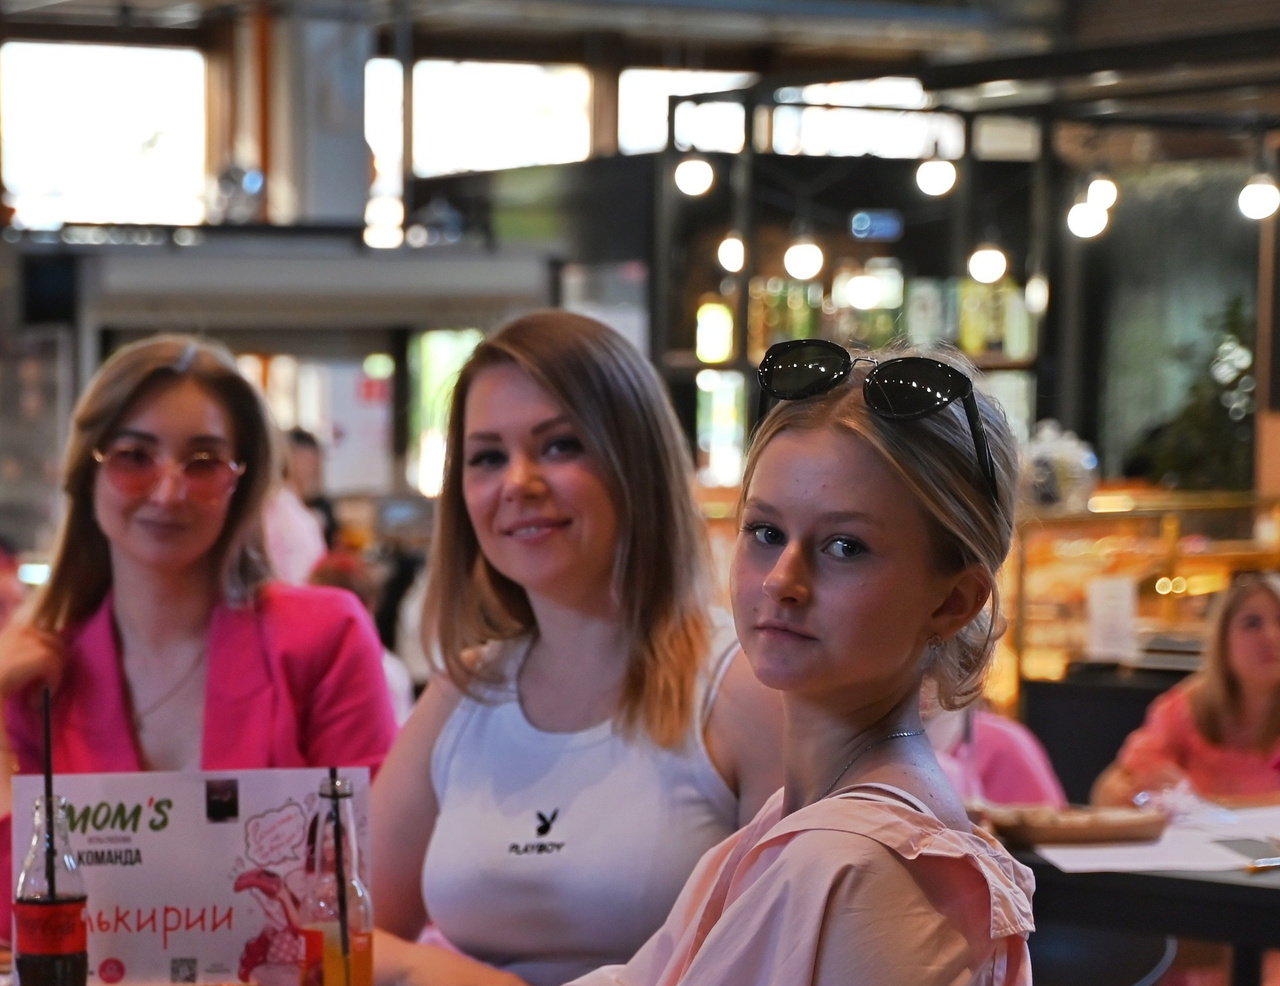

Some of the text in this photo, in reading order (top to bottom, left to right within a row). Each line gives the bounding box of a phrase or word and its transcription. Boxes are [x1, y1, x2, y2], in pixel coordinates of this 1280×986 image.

[65, 796, 173, 834] MOM'S
[77, 849, 142, 866] КОМАНДА
[85, 904, 234, 950] лькирии
